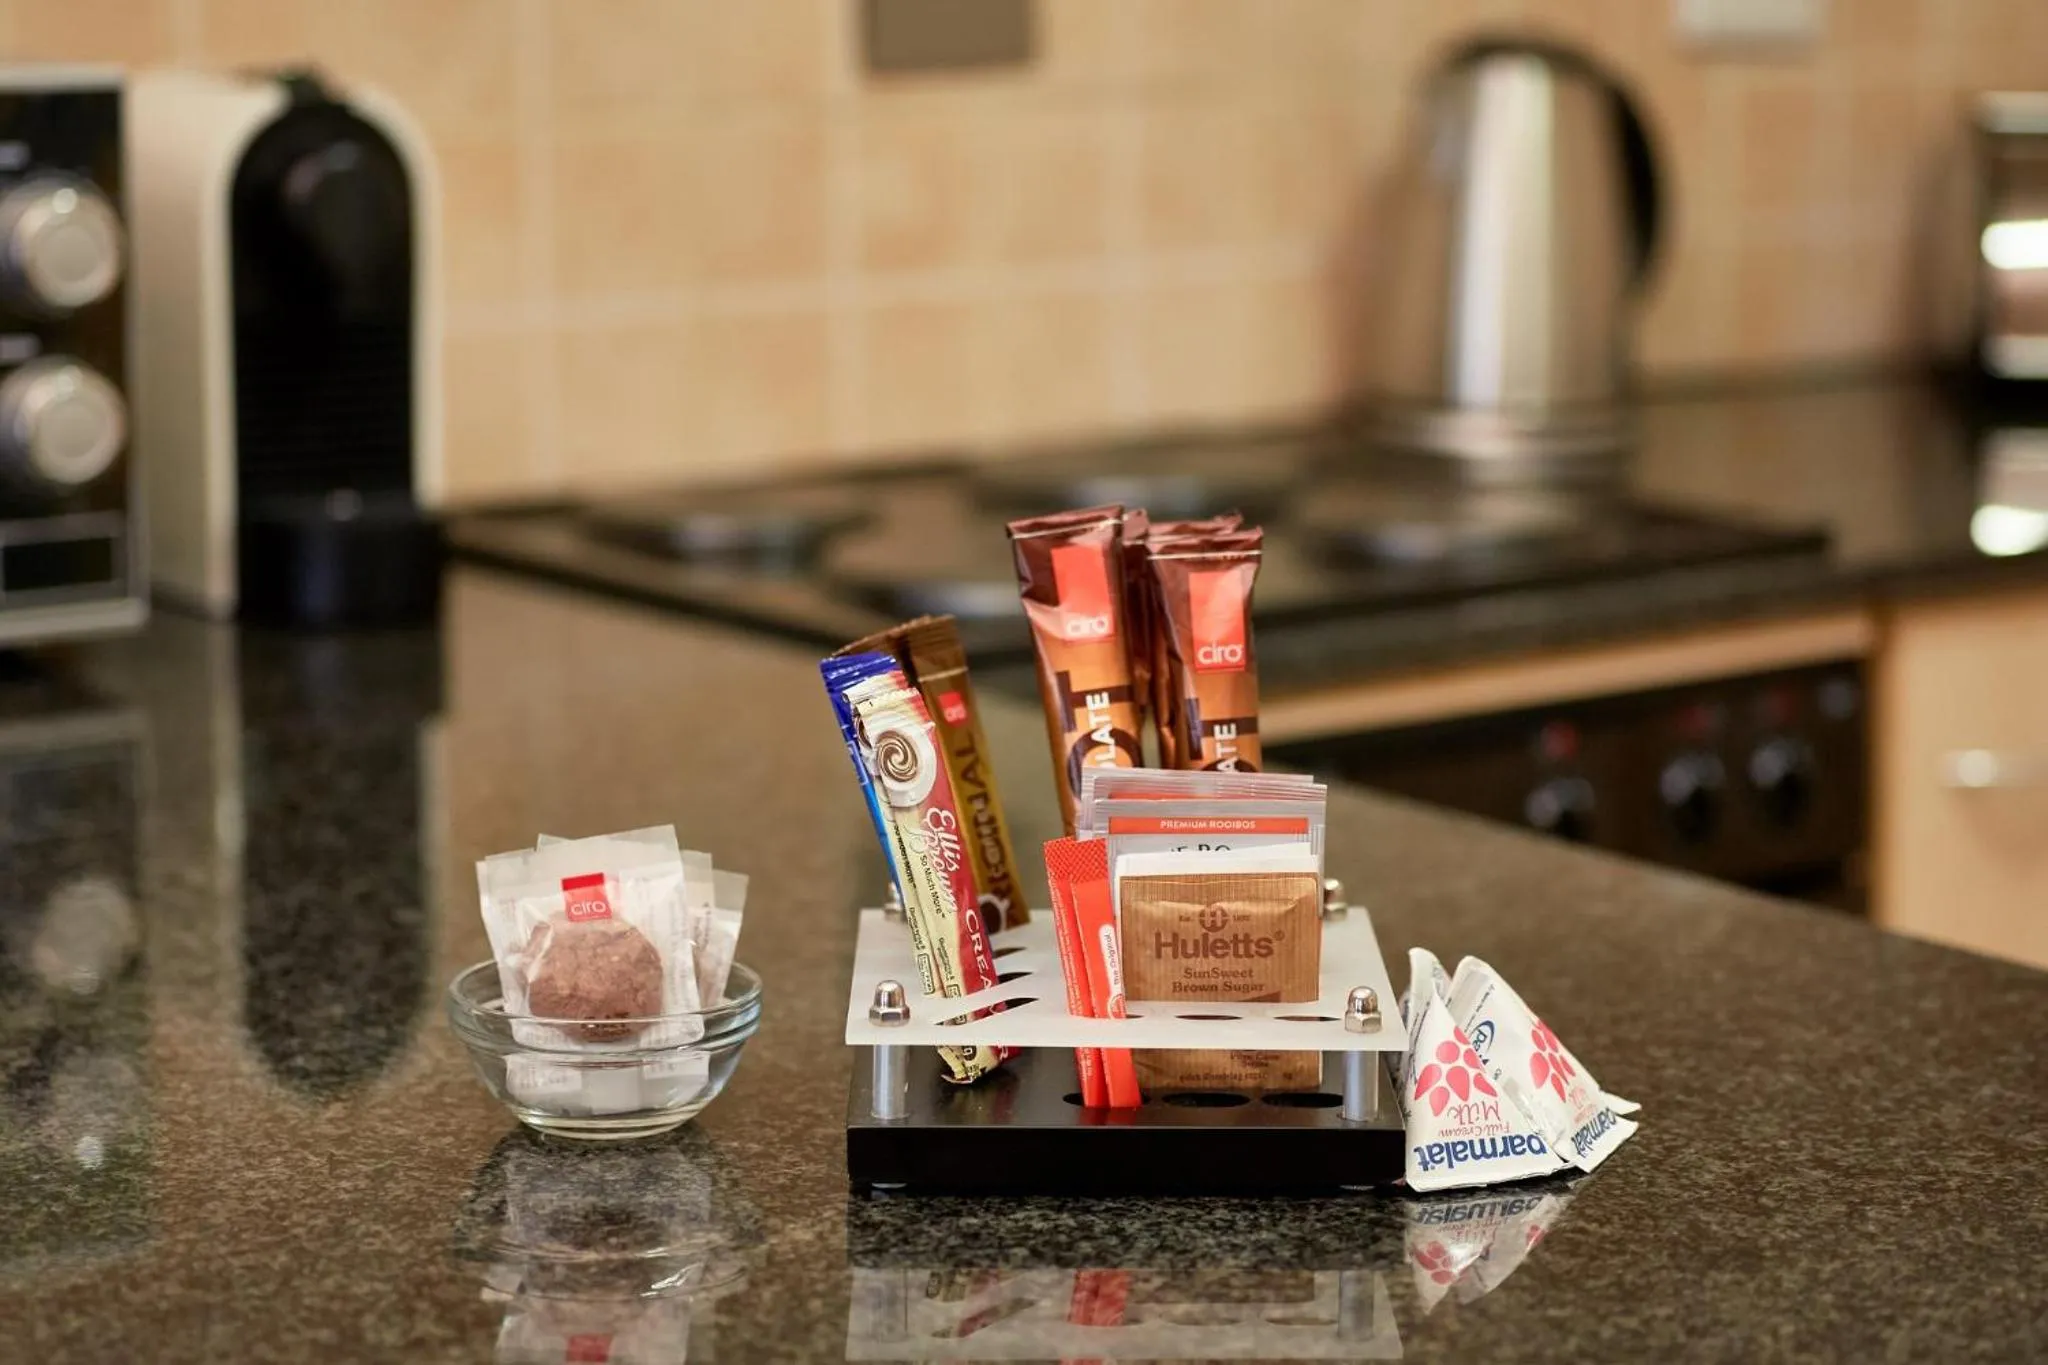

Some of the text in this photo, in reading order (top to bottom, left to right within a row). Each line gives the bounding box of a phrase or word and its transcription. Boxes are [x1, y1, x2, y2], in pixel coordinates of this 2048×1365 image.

[1198, 640, 1243, 665] ciro
[1160, 820, 1257, 829] PREMIUM ROOIBOS
[926, 807, 961, 872] Ellis
[925, 867, 936, 891] Much
[571, 900, 607, 916] ciro
[1183, 967, 1254, 979] SunSweet
[1172, 981, 1265, 993] Brown Sugar
[1447, 1100, 1502, 1125] Milk
[1438, 1121, 1511, 1138] Full Cream
[1413, 1133, 1548, 1172] parmalat
